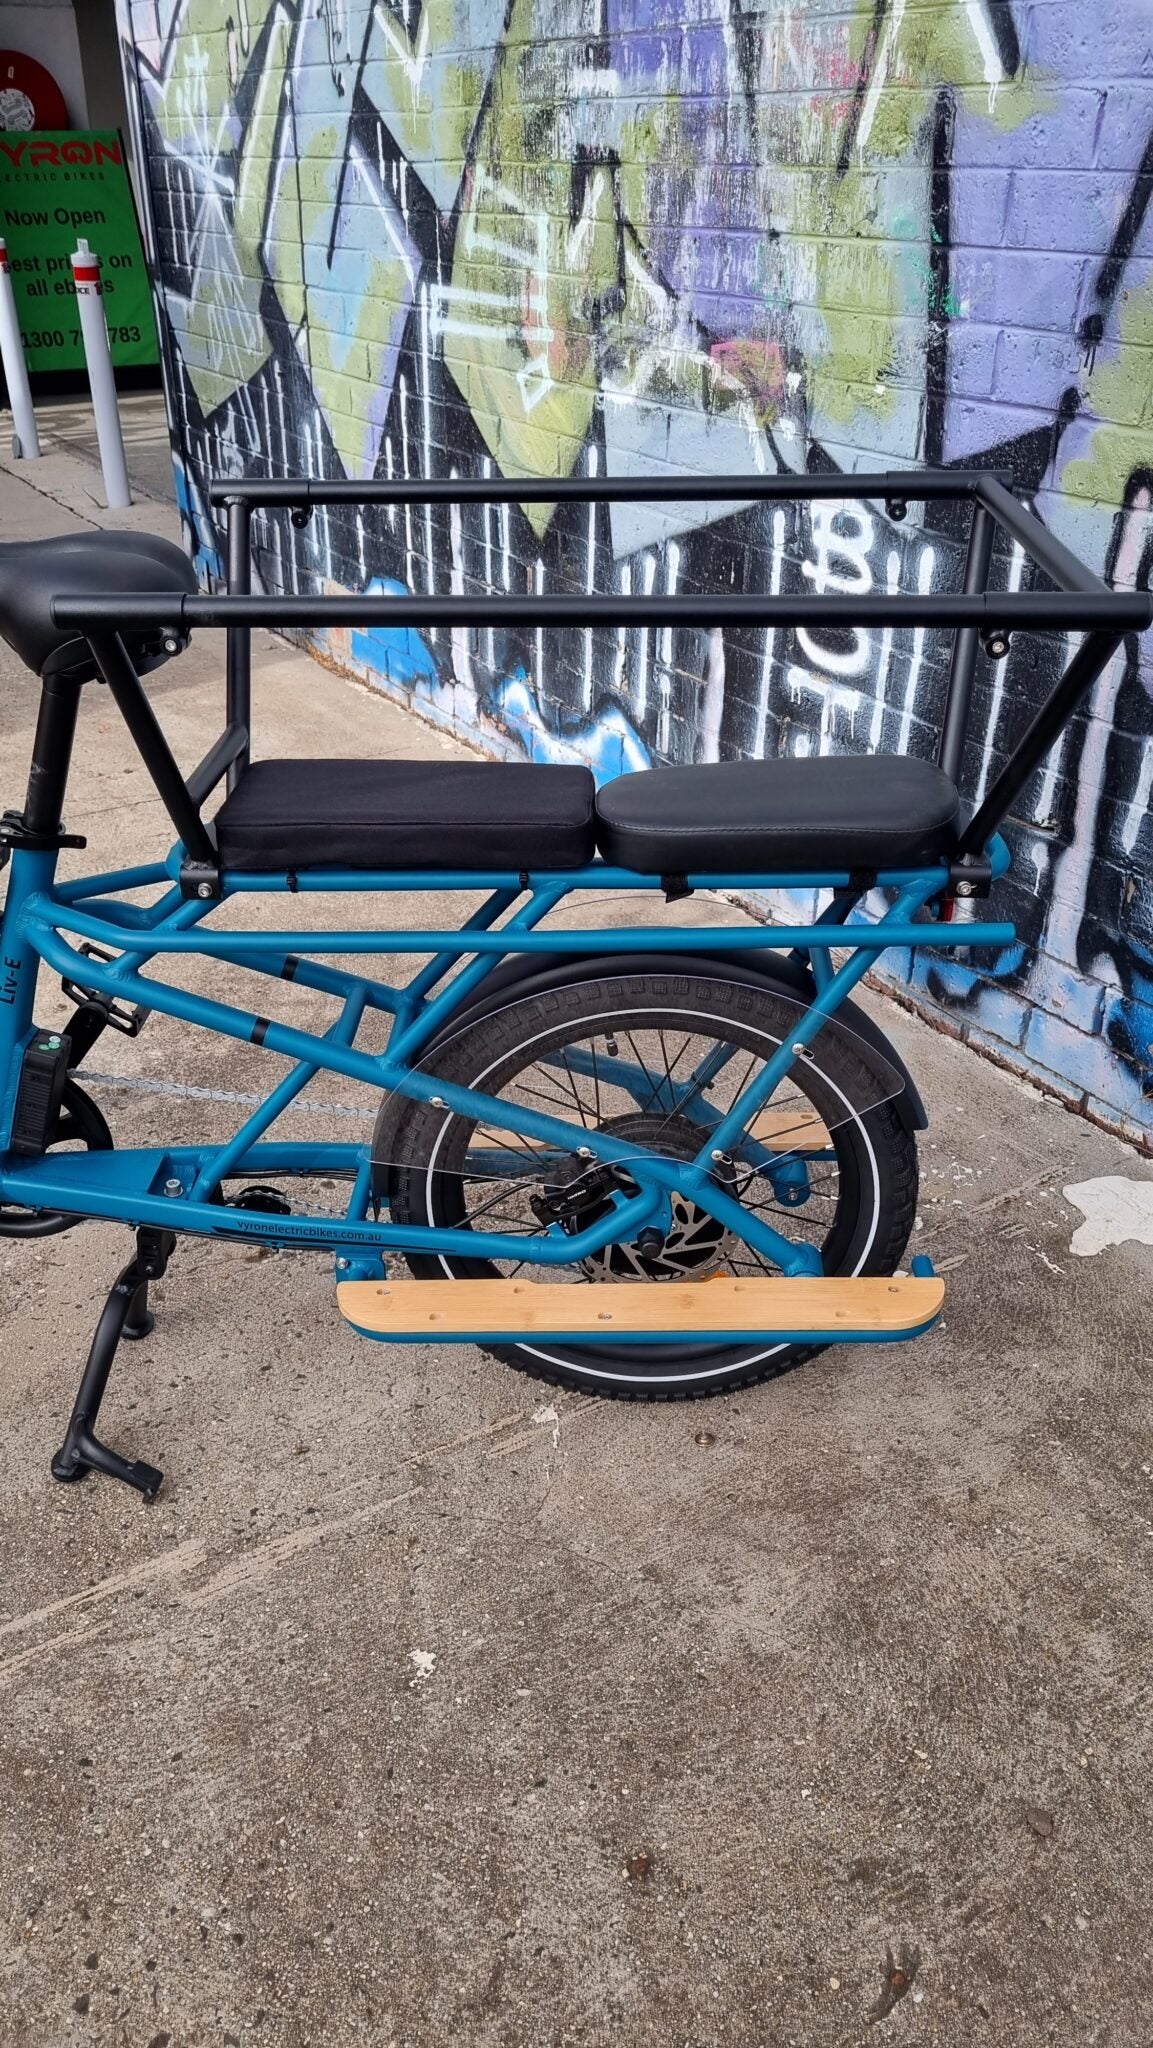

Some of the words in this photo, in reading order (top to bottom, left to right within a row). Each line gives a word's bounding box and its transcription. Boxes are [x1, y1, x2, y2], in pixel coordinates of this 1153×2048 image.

[0, 140, 123, 167] YRON
[0, 172, 57, 182] ECTRIC
[5, 209, 48, 226] Now
[54, 207, 106, 229] Open
[9, 256, 41, 273] est
[46, 253, 104, 275] pris
[109, 254, 132, 268] on
[26, 279, 48, 296] all
[20, 330, 64, 348] 1300
[108, 326, 141, 343] 783
[0, 956, 21, 1004] Liv-E
[237, 1220, 382, 1242] vyronelectricbikes.com.au
